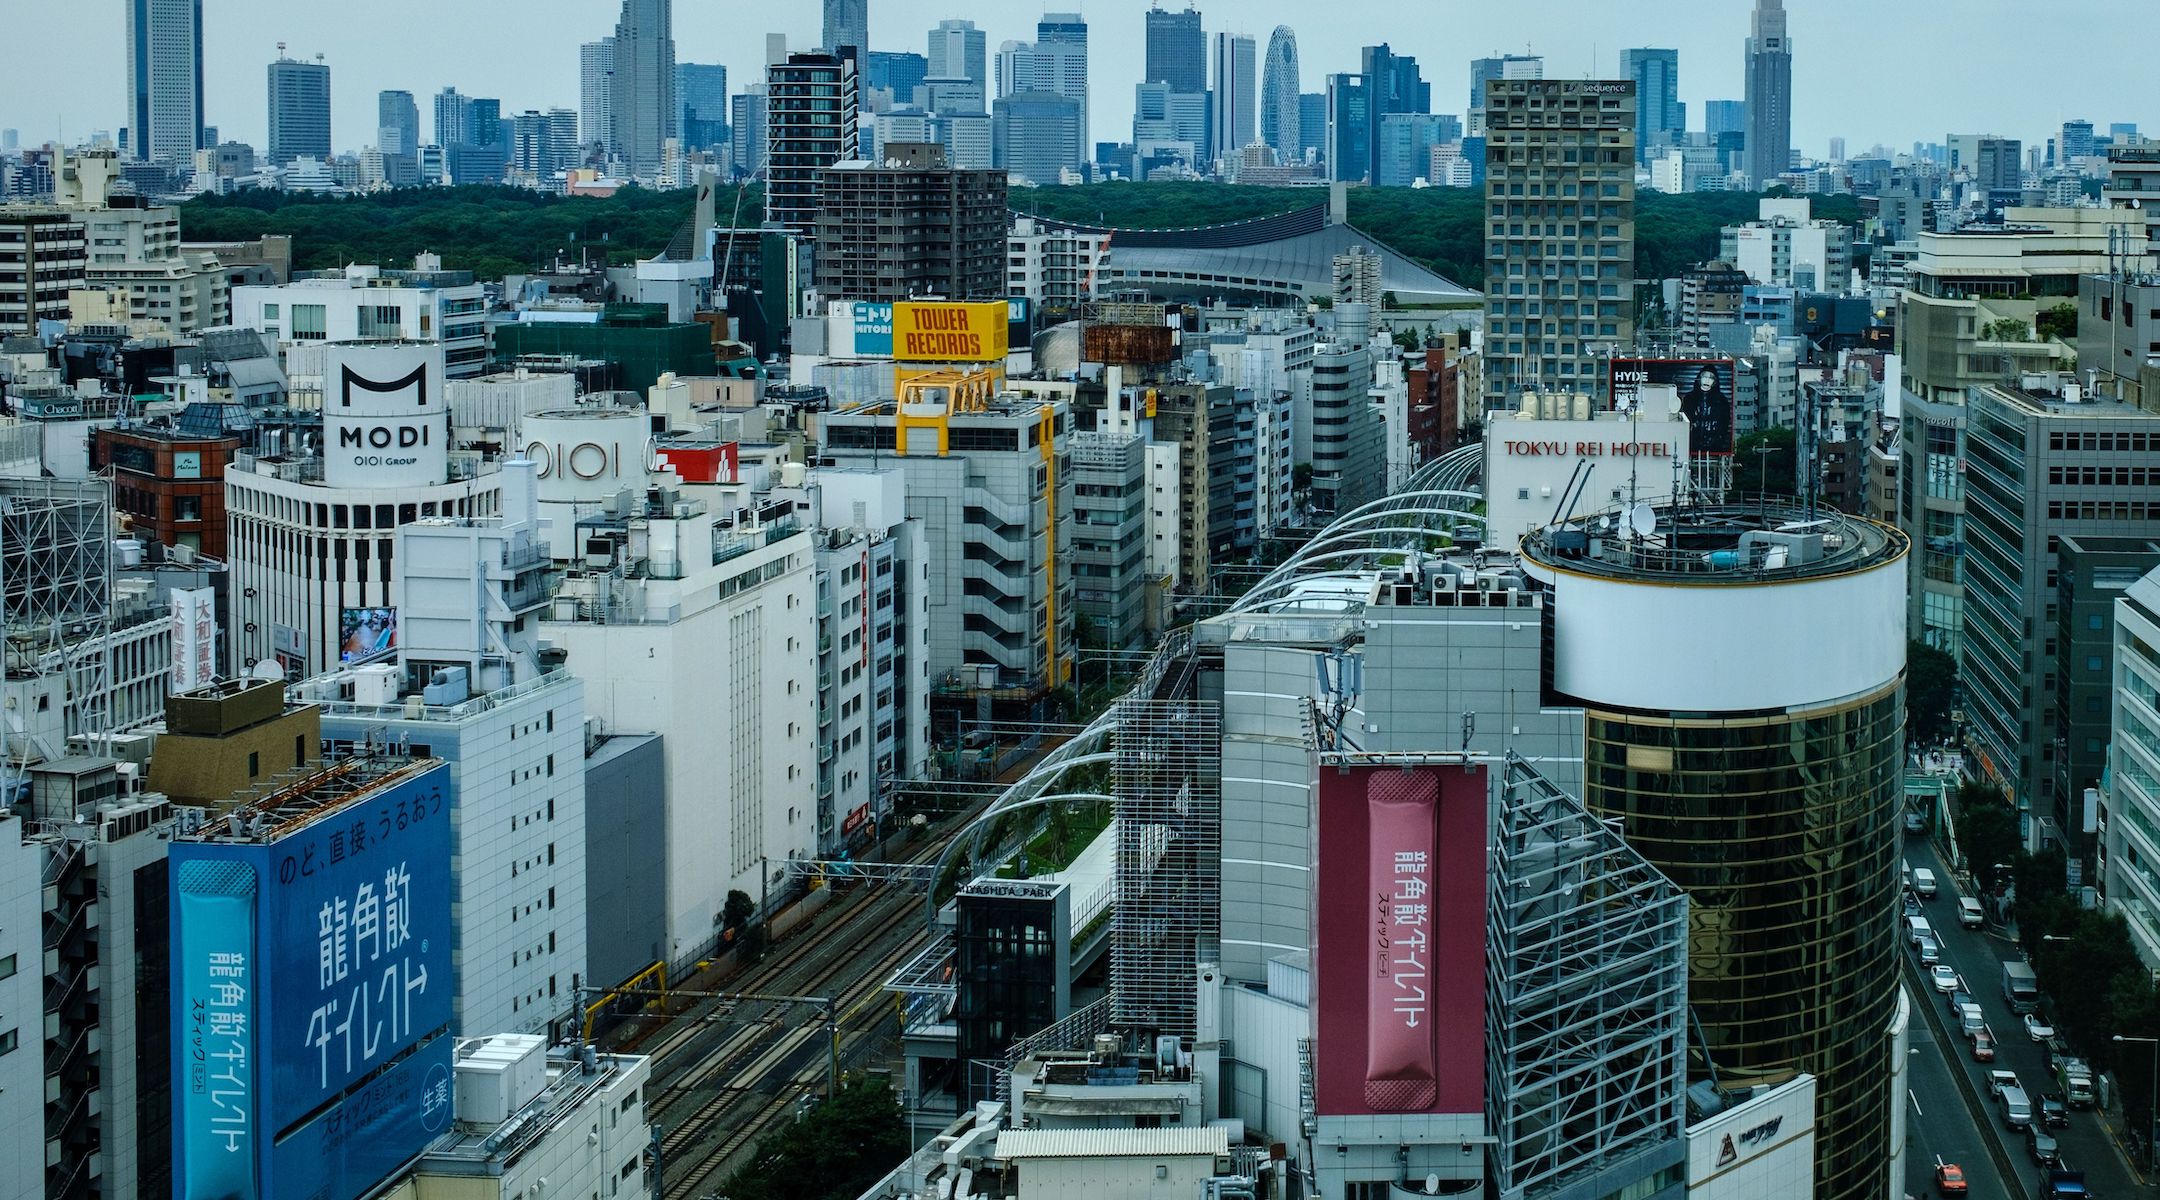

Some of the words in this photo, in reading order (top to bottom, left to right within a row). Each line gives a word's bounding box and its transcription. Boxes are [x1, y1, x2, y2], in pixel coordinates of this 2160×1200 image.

[1584, 84, 1626, 93] sequence
[856, 306, 892, 322] ニトリ
[912, 308, 969, 331] TOWER
[856, 325, 892, 334] NITORI
[906, 333, 981, 355] RECORDS
[1615, 371, 1648, 382] HYDE
[340, 424, 428, 448] MODI
[1504, 441, 1567, 456] TOKYU
[1576, 442, 1603, 456] REI
[1611, 442, 1671, 457] HOTEL
[196, 600, 211, 684] 大和証券
[280, 786, 441, 885] のど、直接、うるおう
[1023, 887, 1052, 897] PARK
[319, 861, 411, 990] 龍角散
[1378, 893, 1389, 949] スティック
[1394, 851, 1428, 1028] 龍角散ダイレクト
[192, 998, 205, 1061] スティック
[305, 957, 428, 1089] ダイレクト
[209, 952, 246, 1153] 龍角散ダイレクト
[194, 1066, 203, 1091] ミント
[422, 1077, 448, 1118] 生薬
